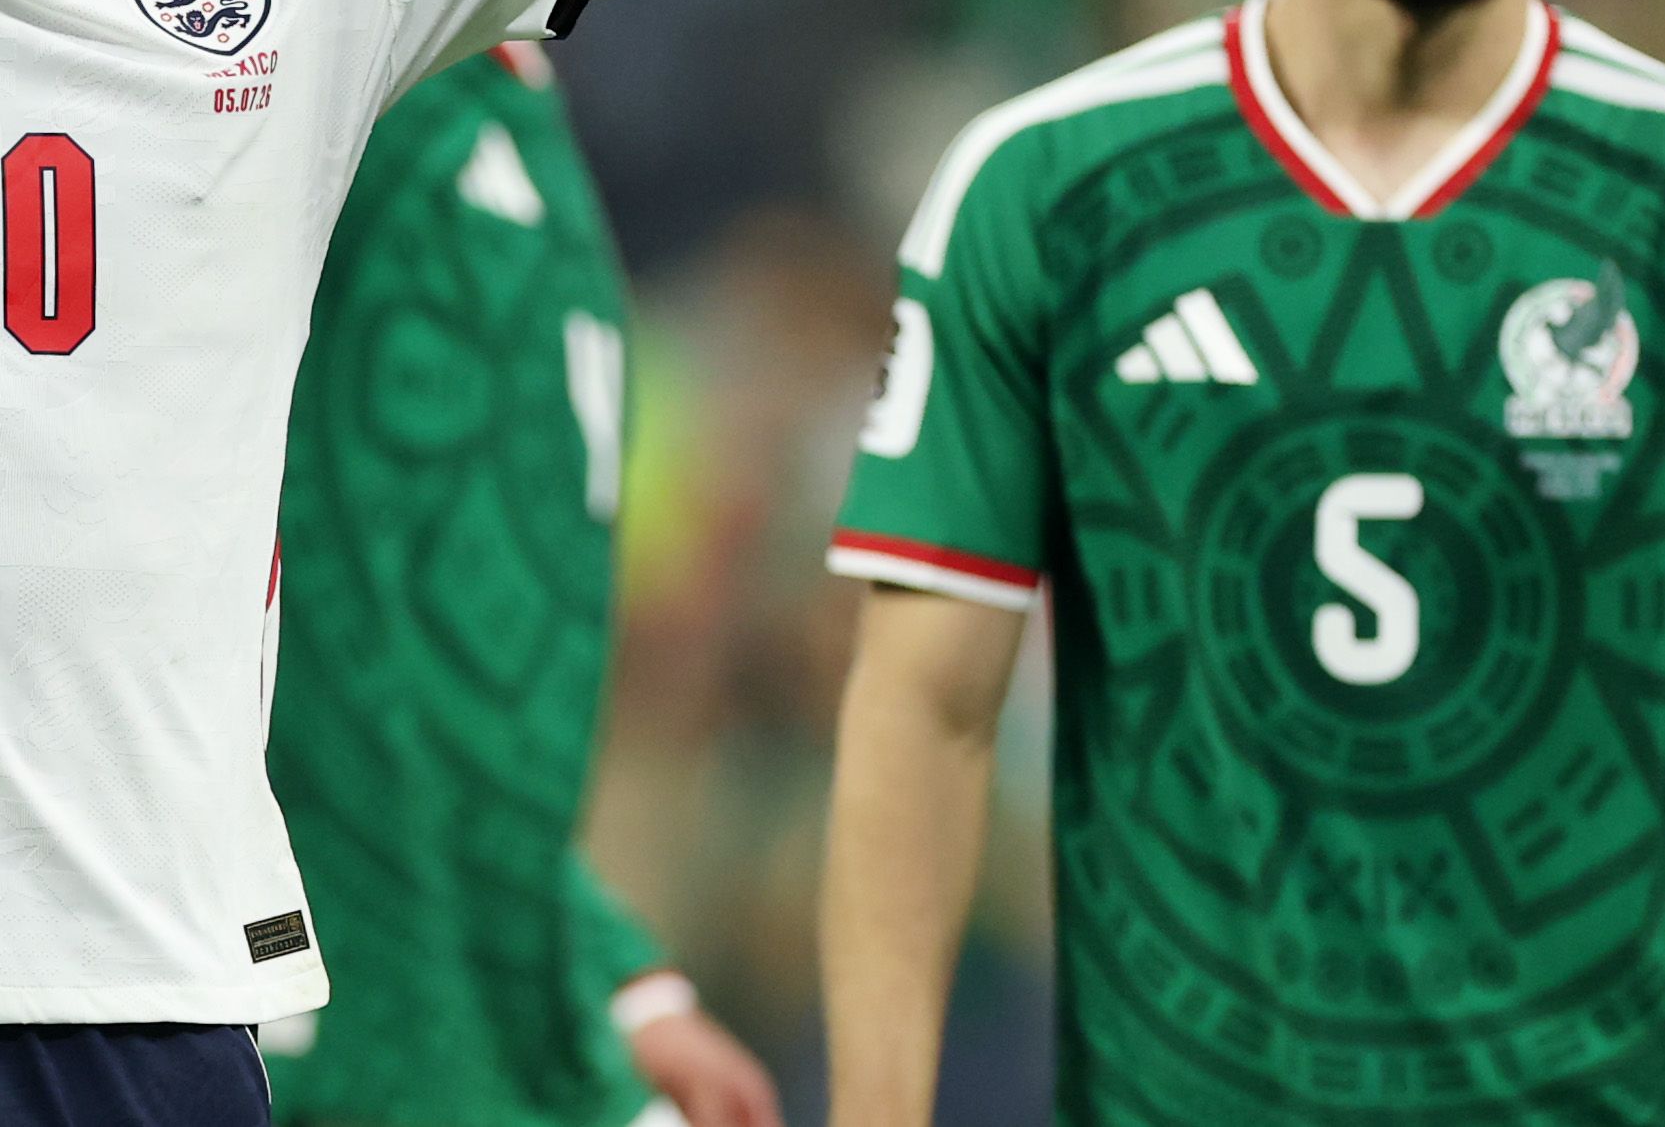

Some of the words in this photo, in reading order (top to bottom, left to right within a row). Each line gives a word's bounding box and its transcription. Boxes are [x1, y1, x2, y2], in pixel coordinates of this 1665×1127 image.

[205, 50, 278, 77] EXICO
[214, 83, 272, 113] 05.07.26
[1312, 472, 1424, 685] 5
